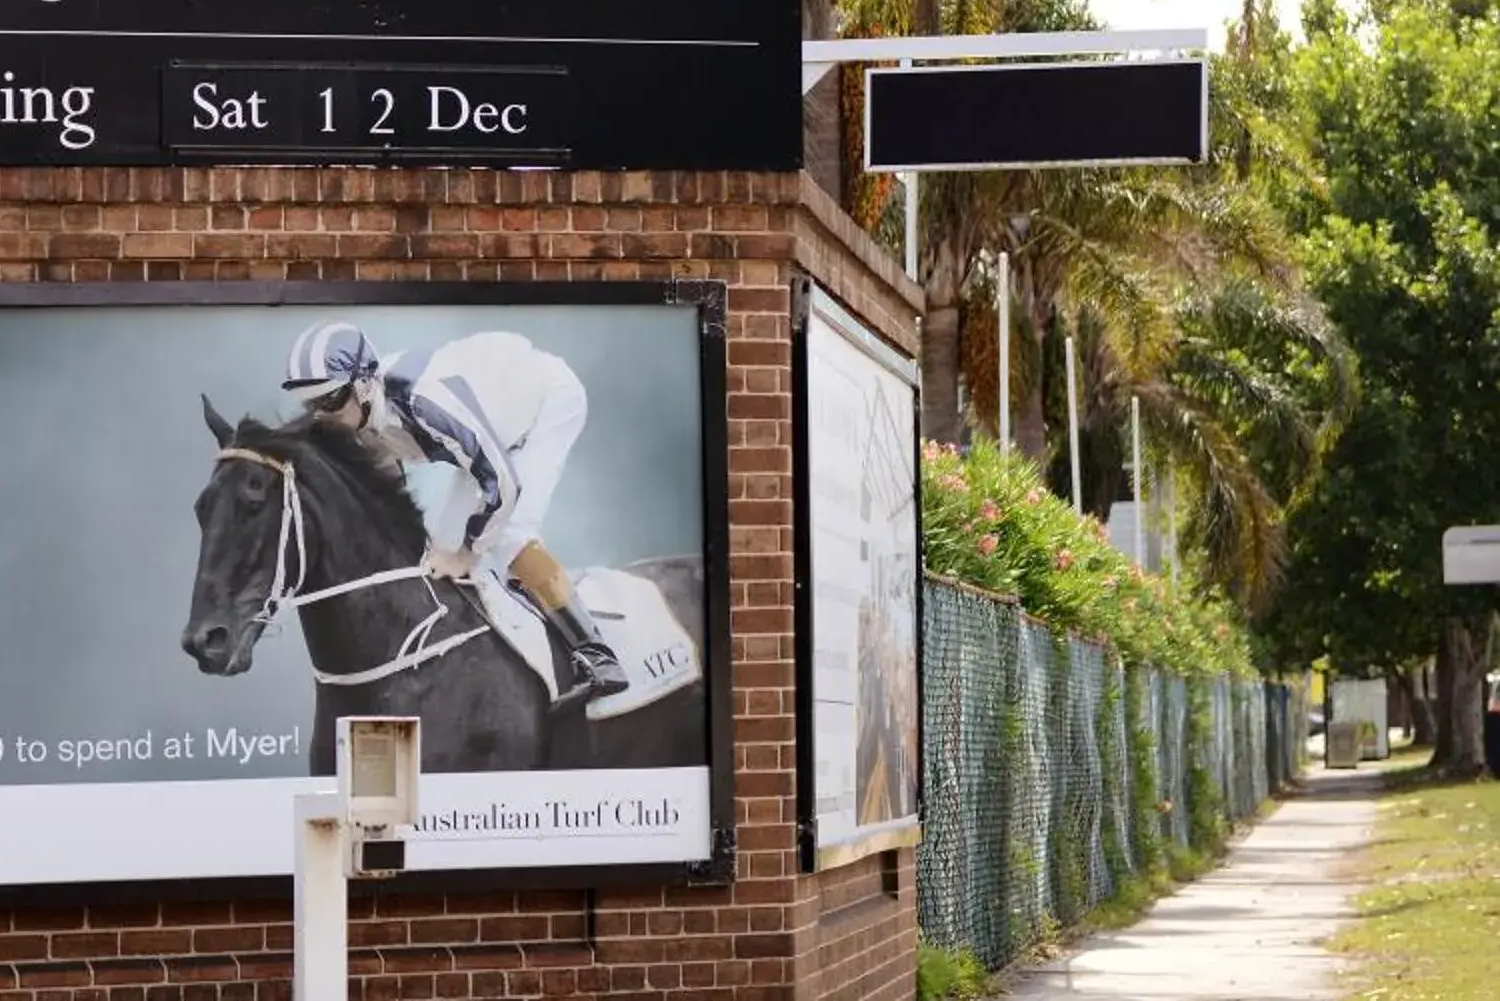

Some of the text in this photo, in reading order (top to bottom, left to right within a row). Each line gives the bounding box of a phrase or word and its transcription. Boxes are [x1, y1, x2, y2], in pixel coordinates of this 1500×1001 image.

[194, 83, 268, 129] Sat
[428, 87, 526, 133] Dec
[16, 737, 46, 762] to
[59, 730, 151, 767] spend
[164, 733, 194, 758] at
[206, 725, 300, 764] Myer!
[409, 798, 680, 833] ustralian Turf Club
